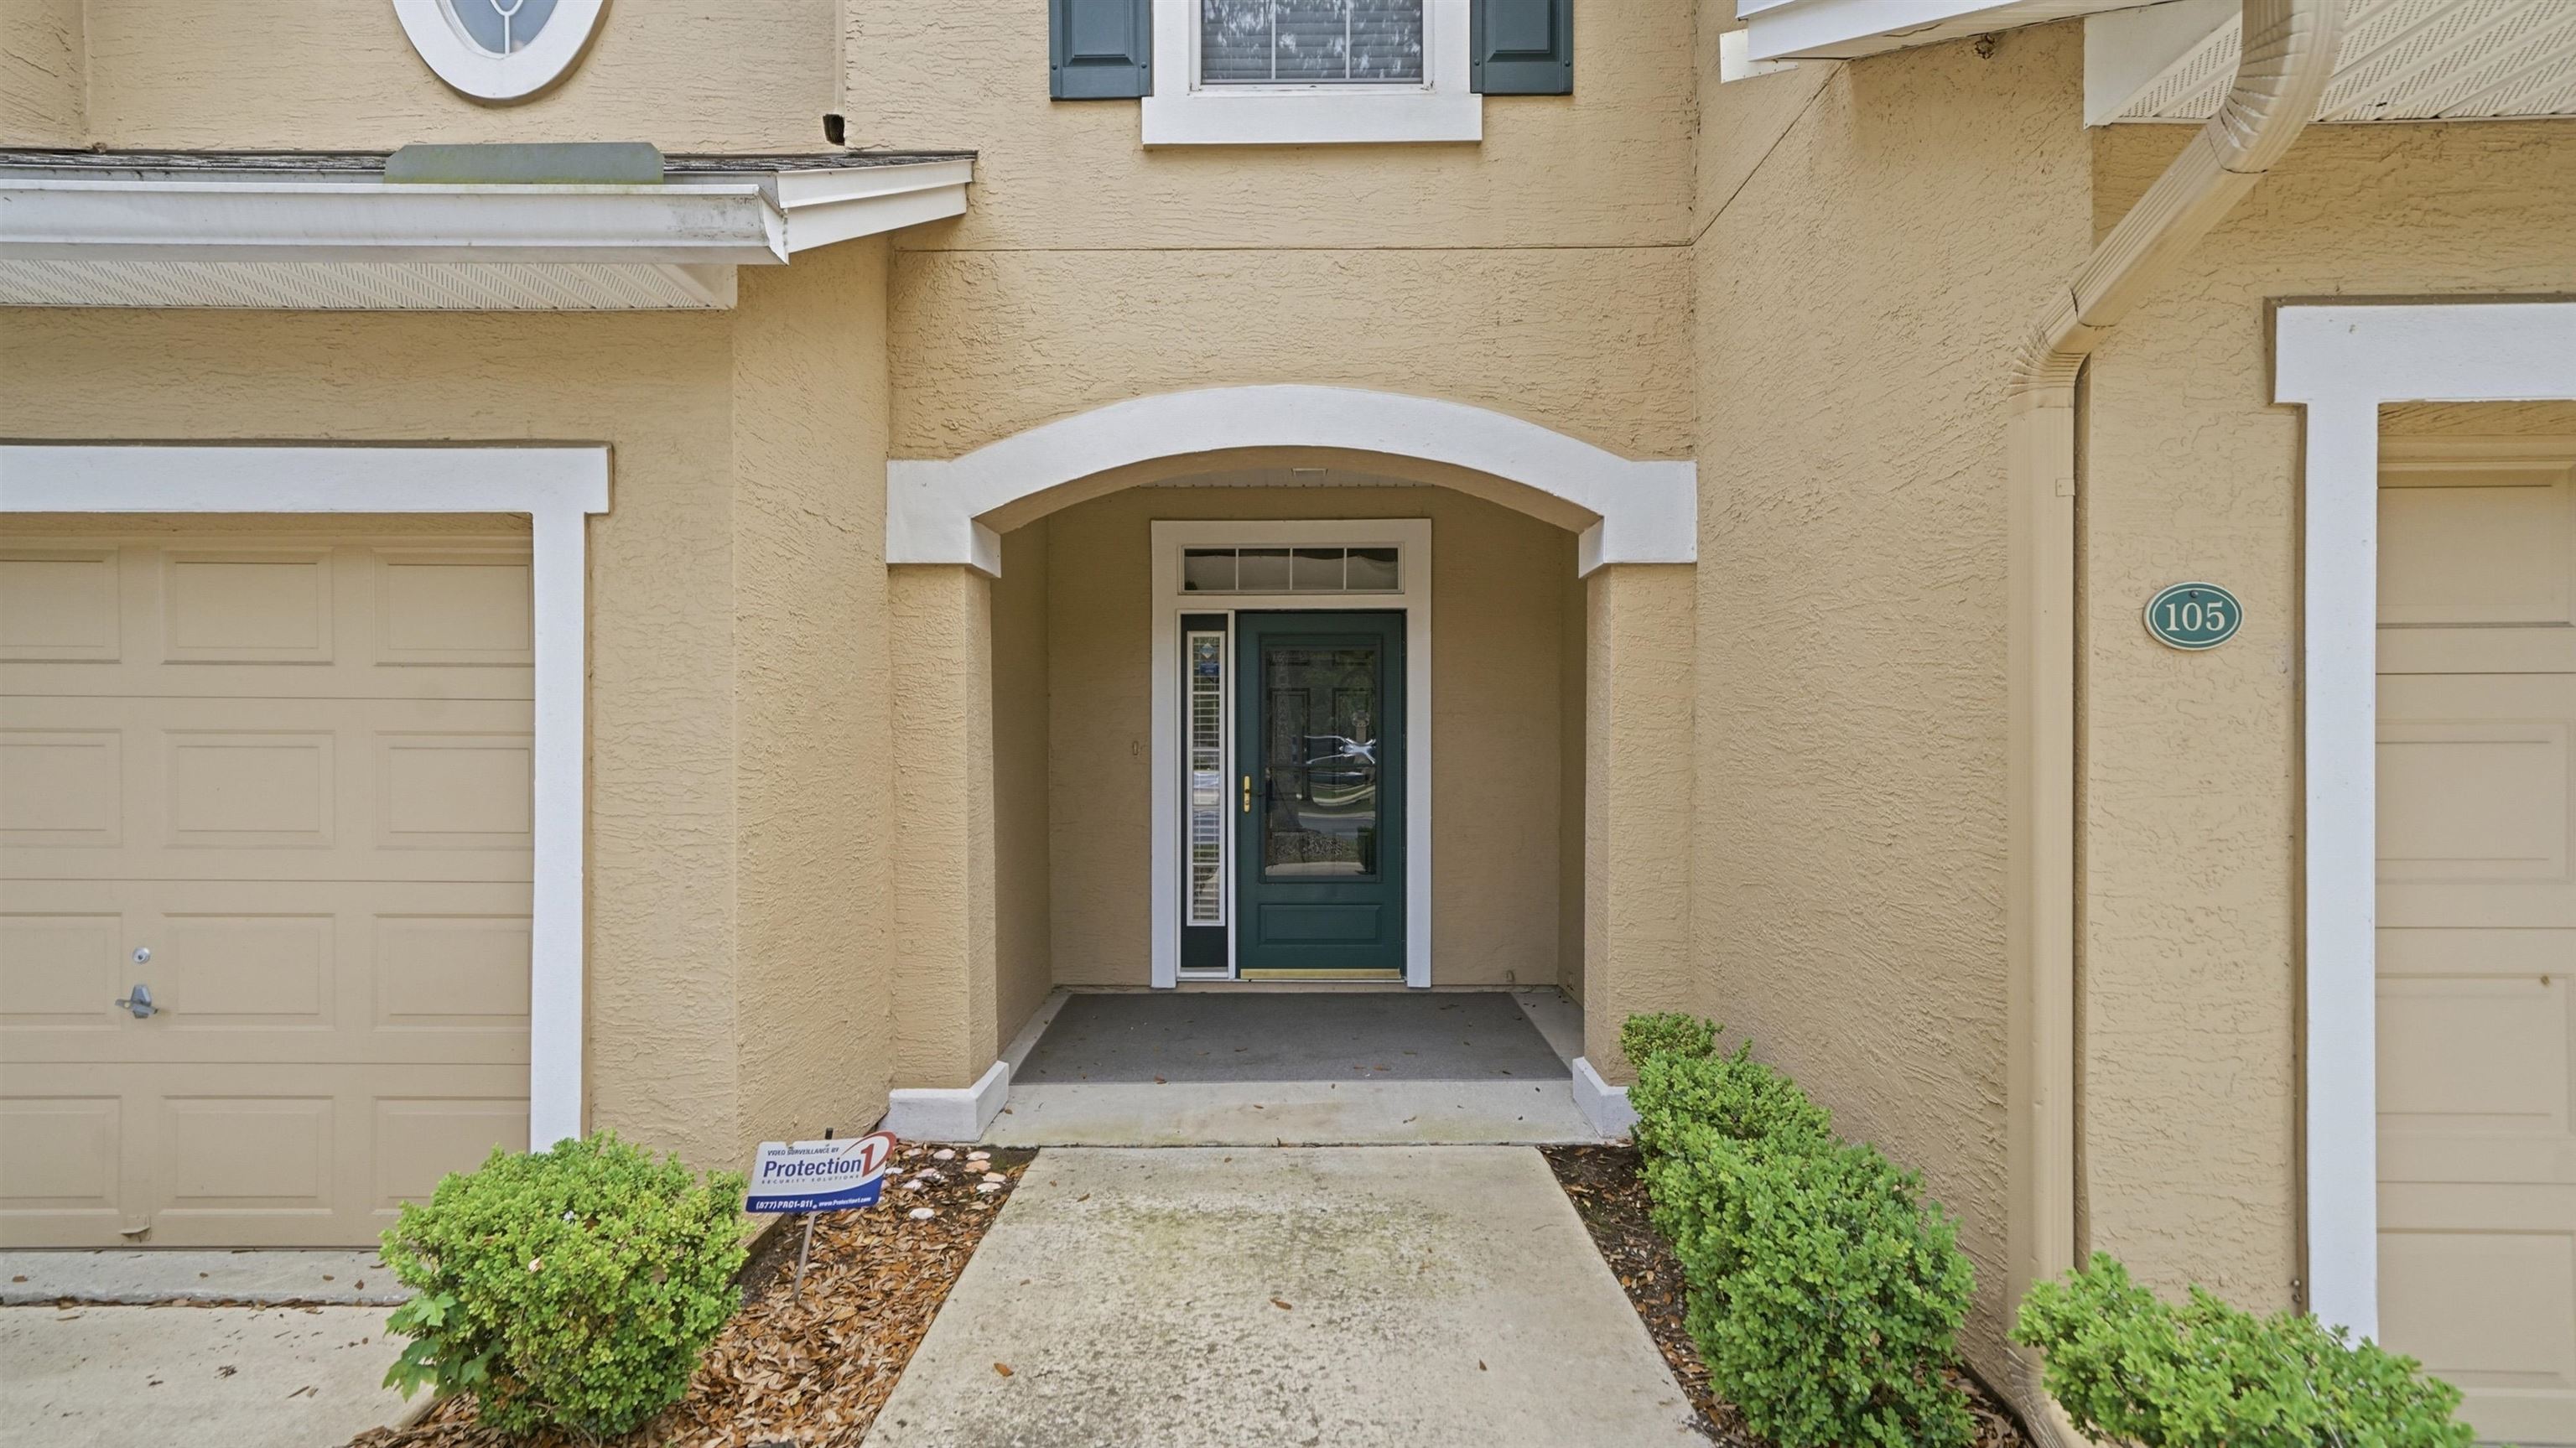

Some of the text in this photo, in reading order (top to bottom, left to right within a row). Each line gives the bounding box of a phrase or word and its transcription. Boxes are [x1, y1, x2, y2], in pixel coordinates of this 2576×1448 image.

[2166, 601, 2225, 631] 105
[787, 1147, 830, 1155] SURVEILLANCE
[763, 1157, 862, 1178] Protection
